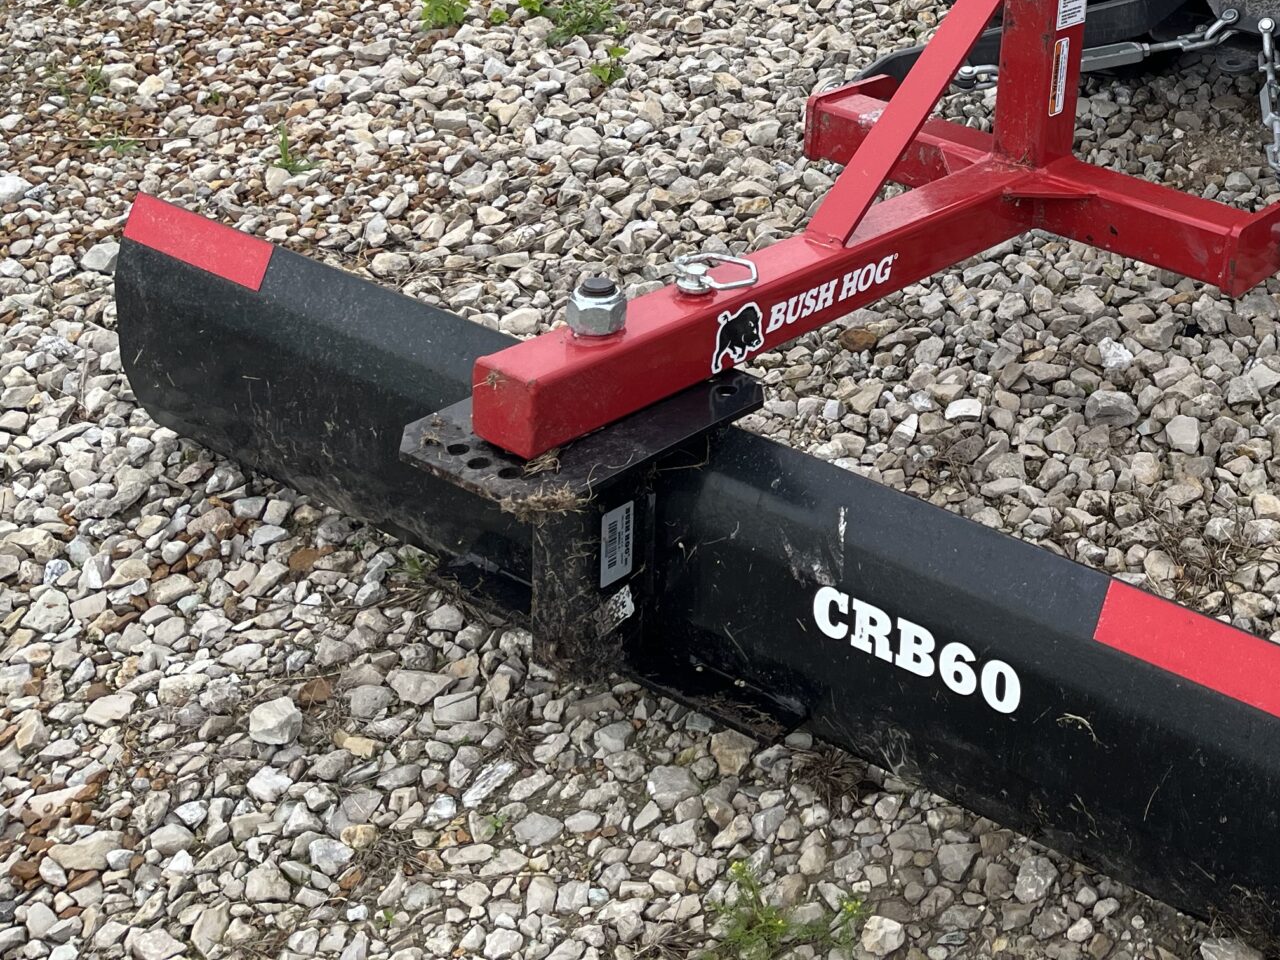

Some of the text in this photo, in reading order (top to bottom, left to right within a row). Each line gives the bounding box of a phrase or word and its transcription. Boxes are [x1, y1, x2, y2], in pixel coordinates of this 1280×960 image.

[765, 254, 894, 334] BUSH HOG
[813, 586, 1021, 714] CRB60
